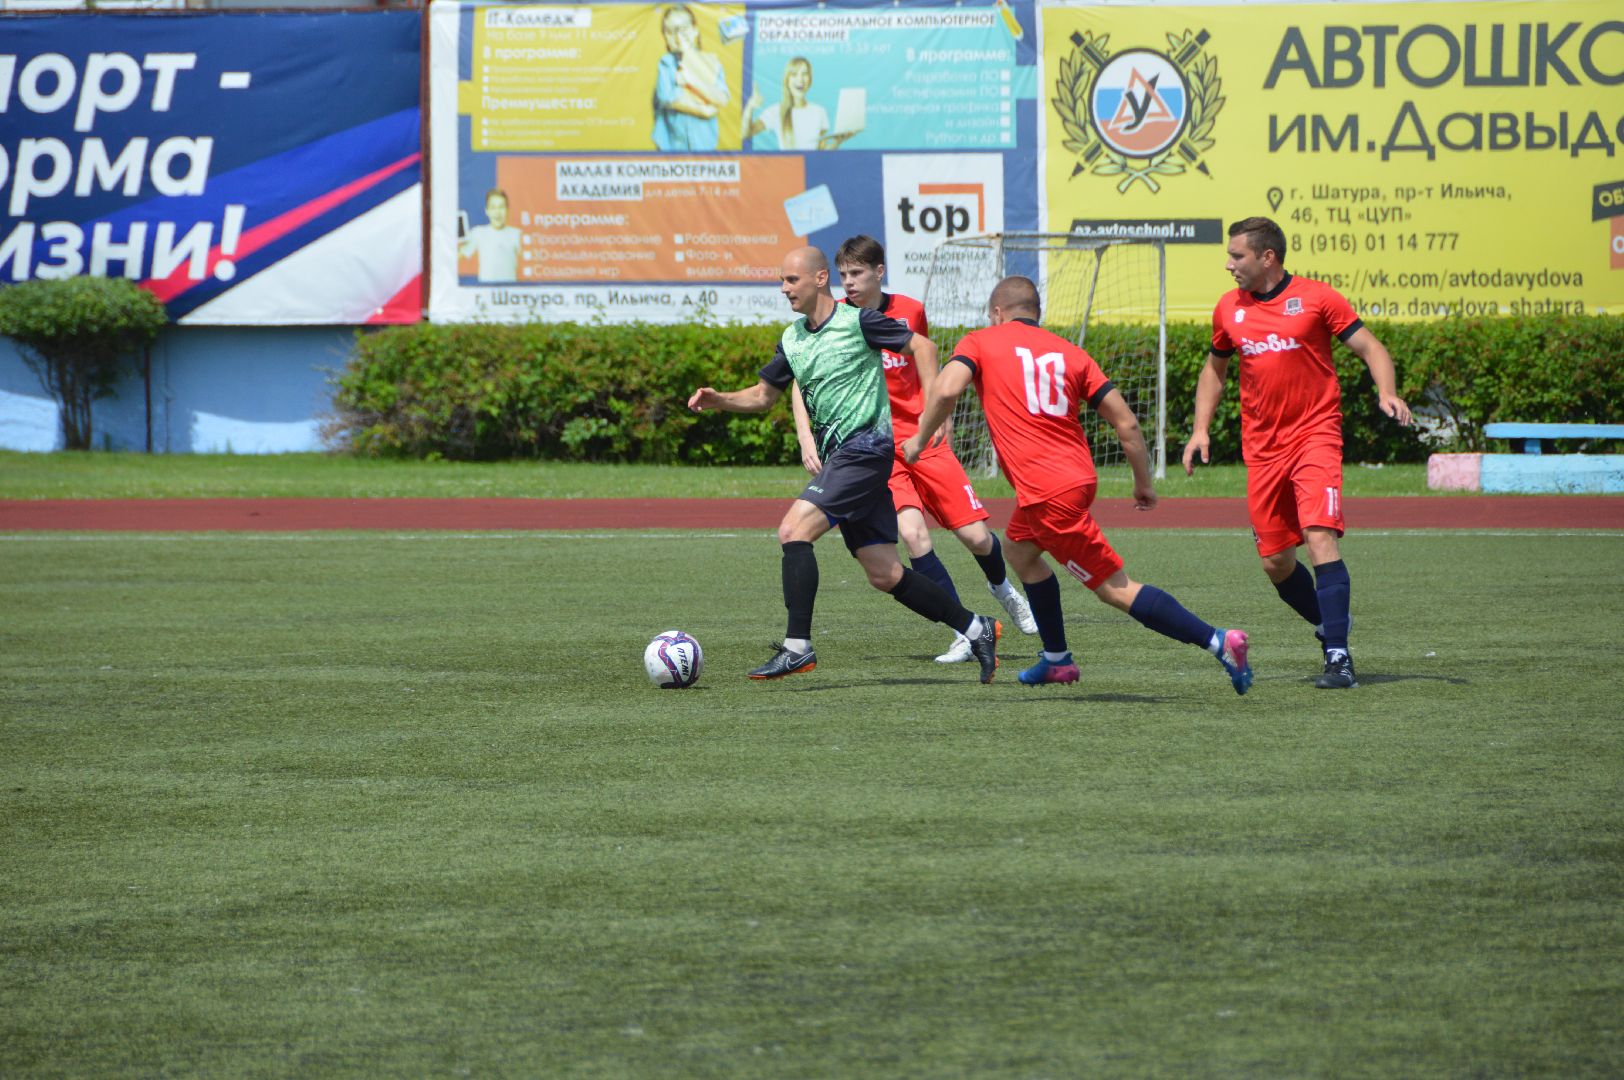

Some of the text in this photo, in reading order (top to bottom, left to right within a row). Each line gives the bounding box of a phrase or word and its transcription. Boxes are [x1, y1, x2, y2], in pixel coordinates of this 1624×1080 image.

[760, 13, 994, 28] ПРОФЕССИОНАЛЬНОЕ КОМПЬЮТЕРНОЕ
[760, 31, 846, 41] ОБРАЗОВАНИЕ
[1262, 20, 1624, 89] АВТОШКО
[1268, 100, 1624, 162] им.Давыд
[0, 136, 214, 217] рма
[559, 163, 737, 178] МАЛАЯ КОМПЬЮТЕРНАЯ
[560, 183, 641, 198] АКАДЕМИЯ
[1290, 183, 1512, 203] г. Шатура, пр-т Ильича,
[534, 213, 630, 230] программе:
[897, 197, 970, 238] top
[1290, 206, 1412, 226] 46, ТЦ «ЦУП»
[1291, 232, 1460, 255] 8 (916) 01 14 777
[491, 290, 570, 310] Шатура,
[608, 288, 676, 307] Ильича,
[1015, 346, 1070, 417] 10
